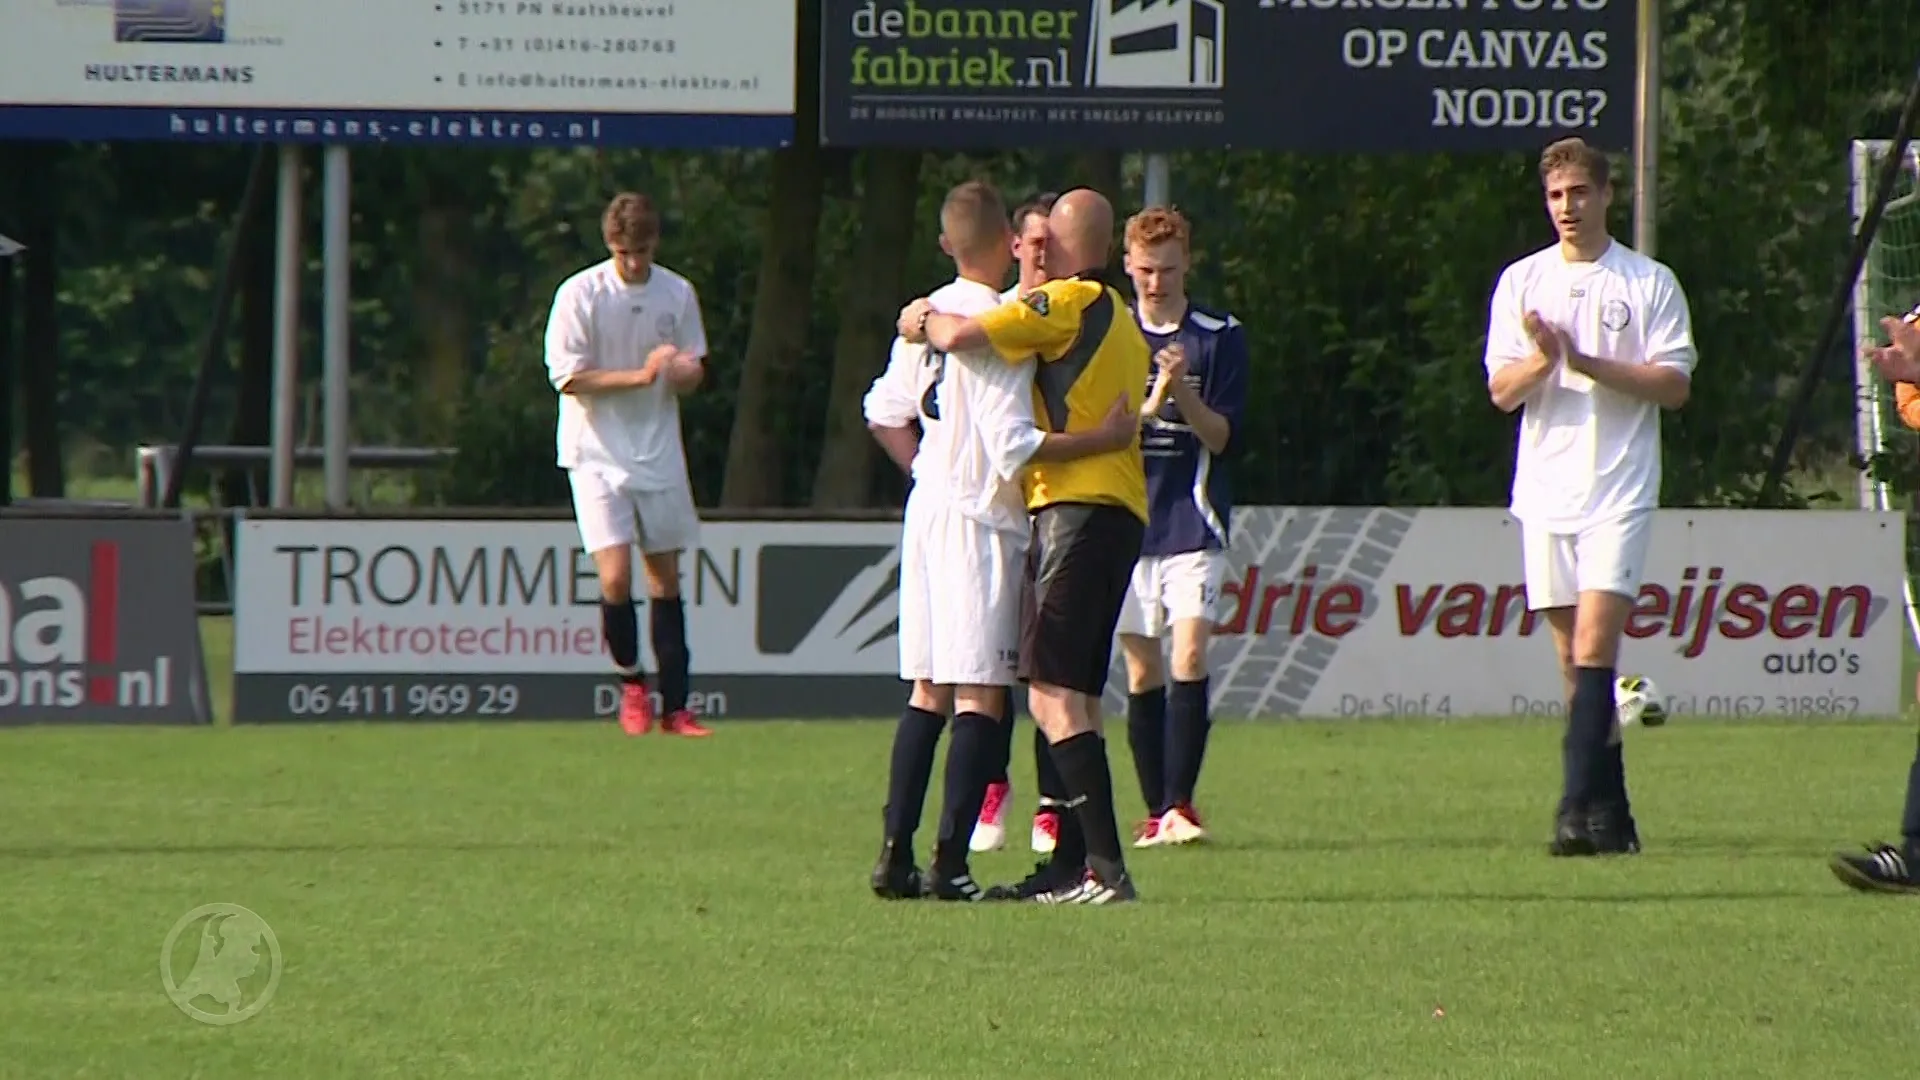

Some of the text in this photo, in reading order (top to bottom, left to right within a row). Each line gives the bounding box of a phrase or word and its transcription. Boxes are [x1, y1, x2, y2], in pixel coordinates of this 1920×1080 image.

[516, 2, 542, 15] PN
[852, 0, 1077, 39] debanner
[457, 37, 468, 49] T
[480, 38, 513, 51] +31
[1342, 28, 1608, 69] OP CANVAS
[84, 65, 255, 83] HULTERMANS
[458, 73, 467, 87] E
[851, 46, 1073, 87] fabriek.nl
[1432, 89, 1608, 128] NODIG?
[169, 112, 601, 138] hultermans-elektro.nl
[274, 545, 741, 607] TROMMEN
[1623, 566, 1872, 658] eijsen
[1763, 648, 1860, 674] auto's
[288, 684, 331, 715] 06
[336, 684, 396, 714] 411
[407, 684, 470, 715] 969
[477, 684, 519, 714] 29
[1436, 693, 1451, 715] 4
